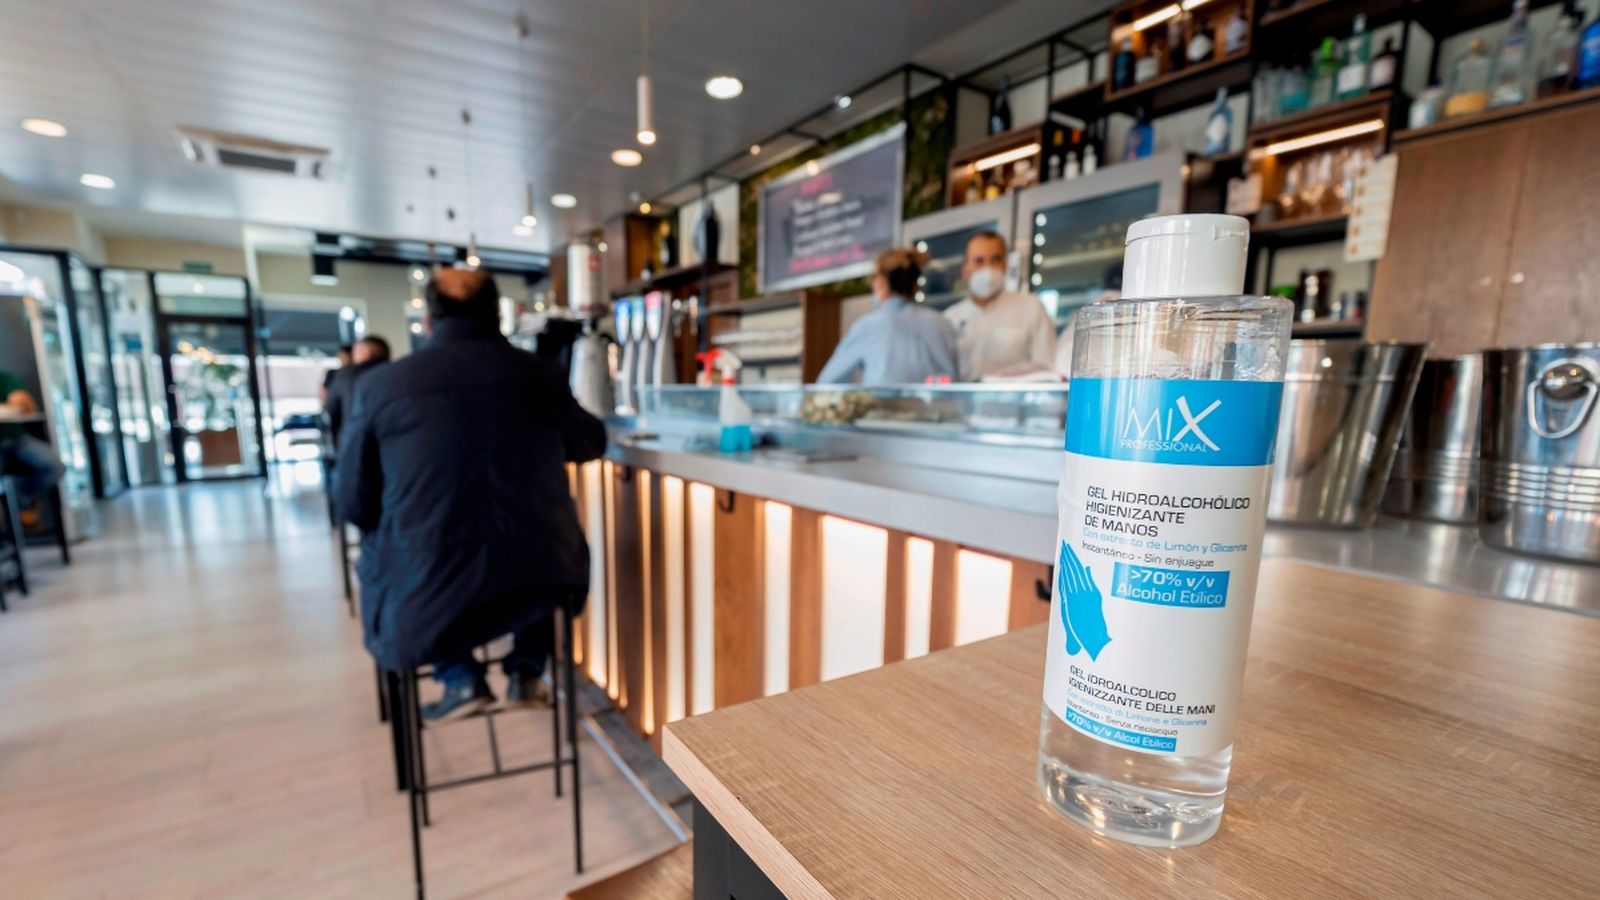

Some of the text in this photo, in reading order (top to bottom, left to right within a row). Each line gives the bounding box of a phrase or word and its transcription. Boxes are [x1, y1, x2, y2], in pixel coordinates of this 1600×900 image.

[1120, 439, 1207, 453] PROFESSIONAL
[1087, 485, 1250, 510] GEL HIDROALCOHÓLICO
[1085, 500, 1185, 524] HIGIENIZANTE
[1084, 515, 1158, 537] DE MANOS
[1083, 527, 1098, 540] Con
[1099, 533, 1143, 548] extracto
[1146, 539, 1161, 549] de
[1164, 541, 1199, 553] Limón
[1202, 545, 1209, 555] y
[1144, 553, 1162, 564] Sin
[1164, 556, 1215, 569] enjuague
[1130, 569, 1215, 591] >70% v/v
[1115, 582, 1176, 604] Alcohol
[1070, 664, 1176, 701] GEL IDROALCOLICO
[1068, 675, 1216, 715] IGIENIZZANTE DELLE MANI
[1113, 730, 1141, 745] Alcol
